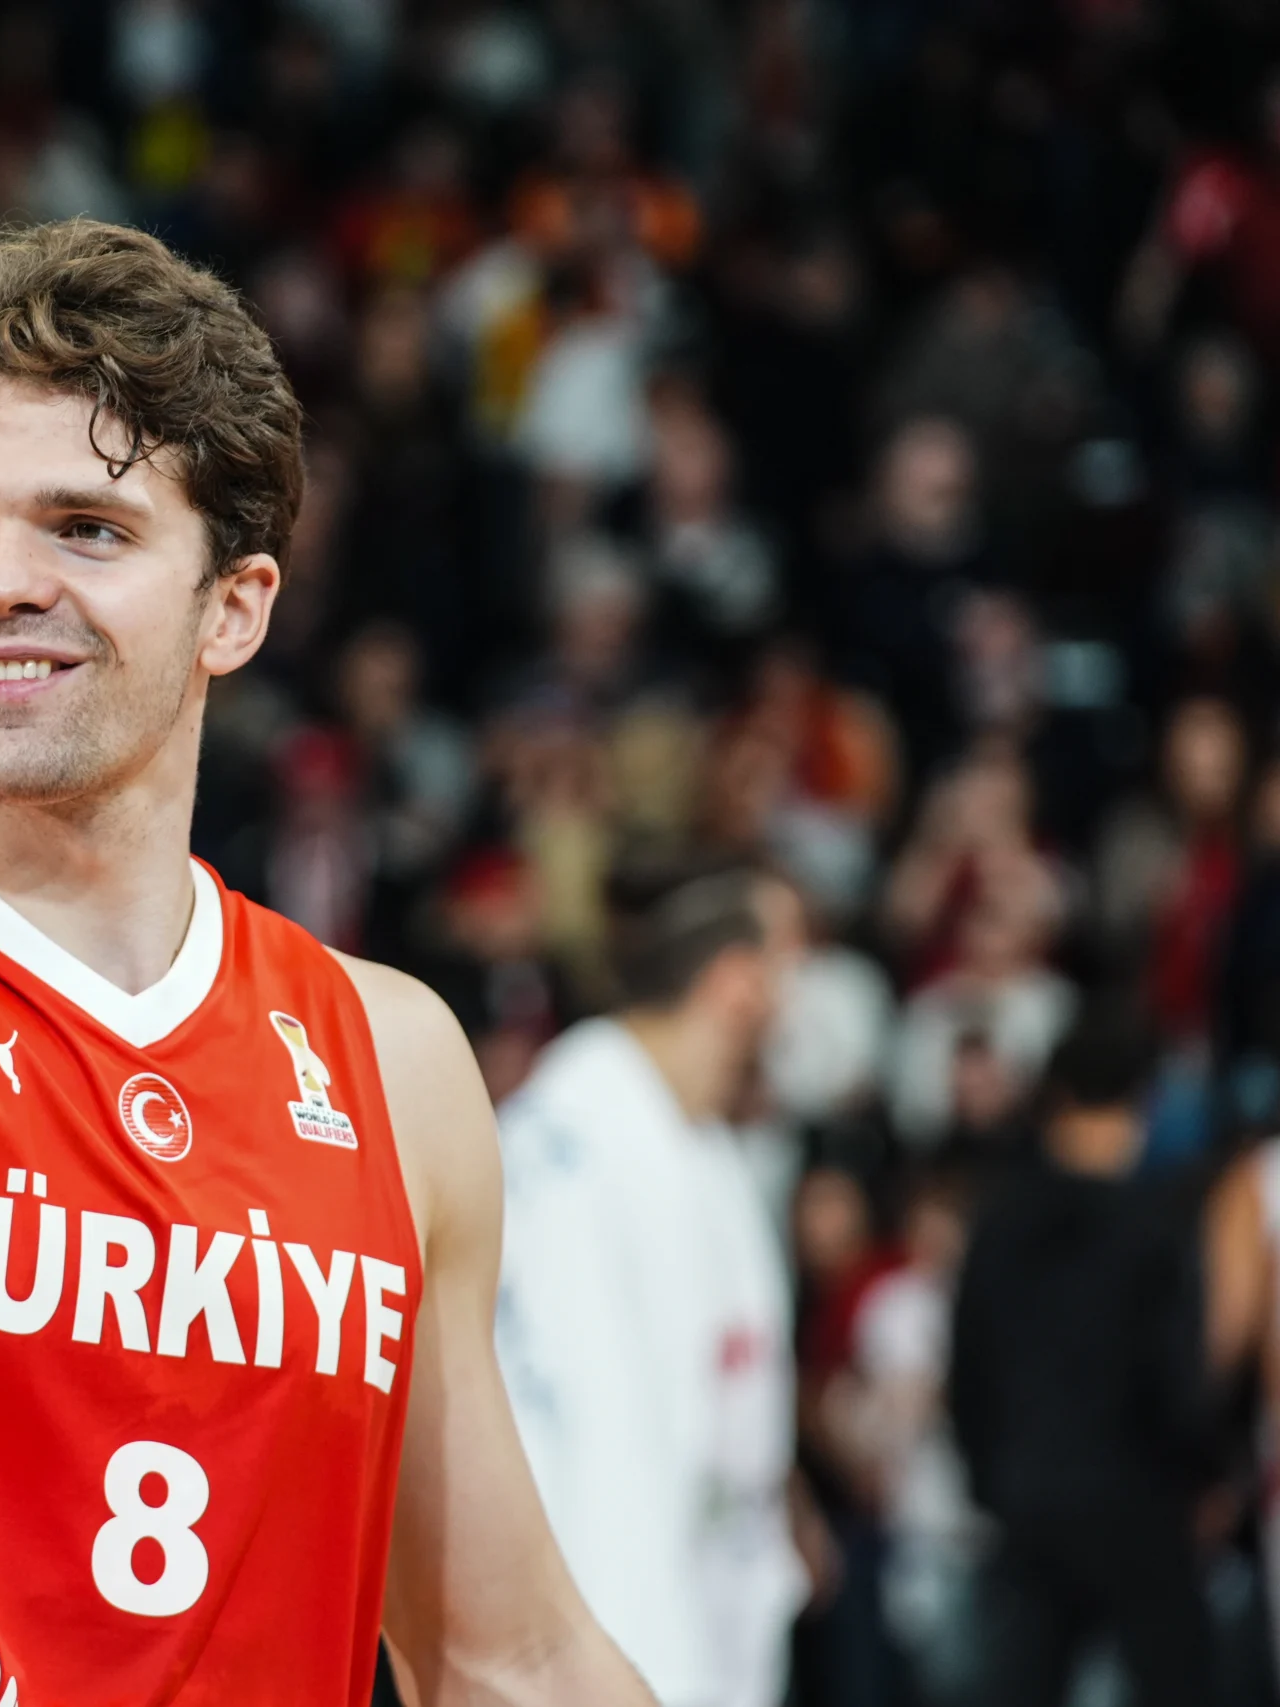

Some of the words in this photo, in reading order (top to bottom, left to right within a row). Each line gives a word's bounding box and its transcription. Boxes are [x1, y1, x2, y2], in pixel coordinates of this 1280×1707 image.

[295, 1110, 330, 1124] WORLD
[332, 1117, 349, 1128] CUP
[299, 1121, 355, 1144] QUALIFIERS
[91, 1440, 210, 1618] 8
